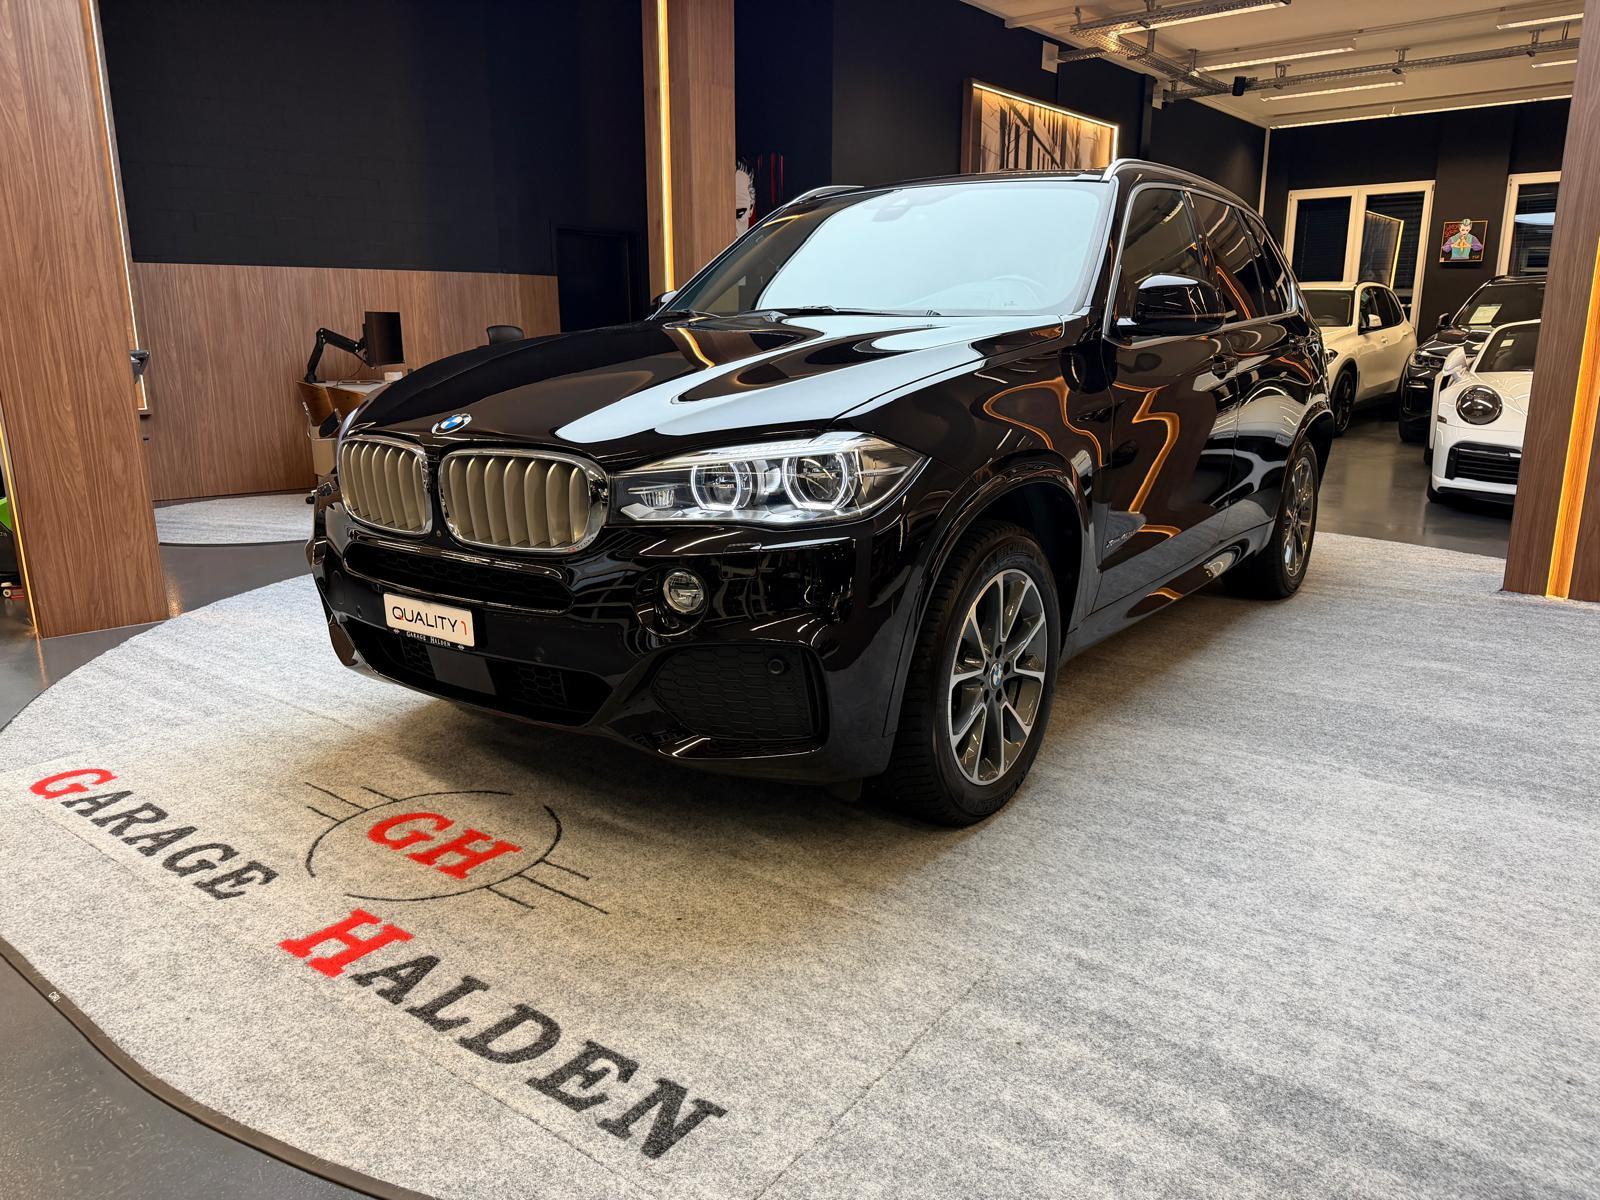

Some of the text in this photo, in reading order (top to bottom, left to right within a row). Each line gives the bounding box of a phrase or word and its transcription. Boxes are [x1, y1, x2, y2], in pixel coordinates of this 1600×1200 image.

[392, 606, 467, 636] QUALITY 1
[367, 812, 522, 880] GH
[31, 768, 727, 1160] GARAGE HALDEN
